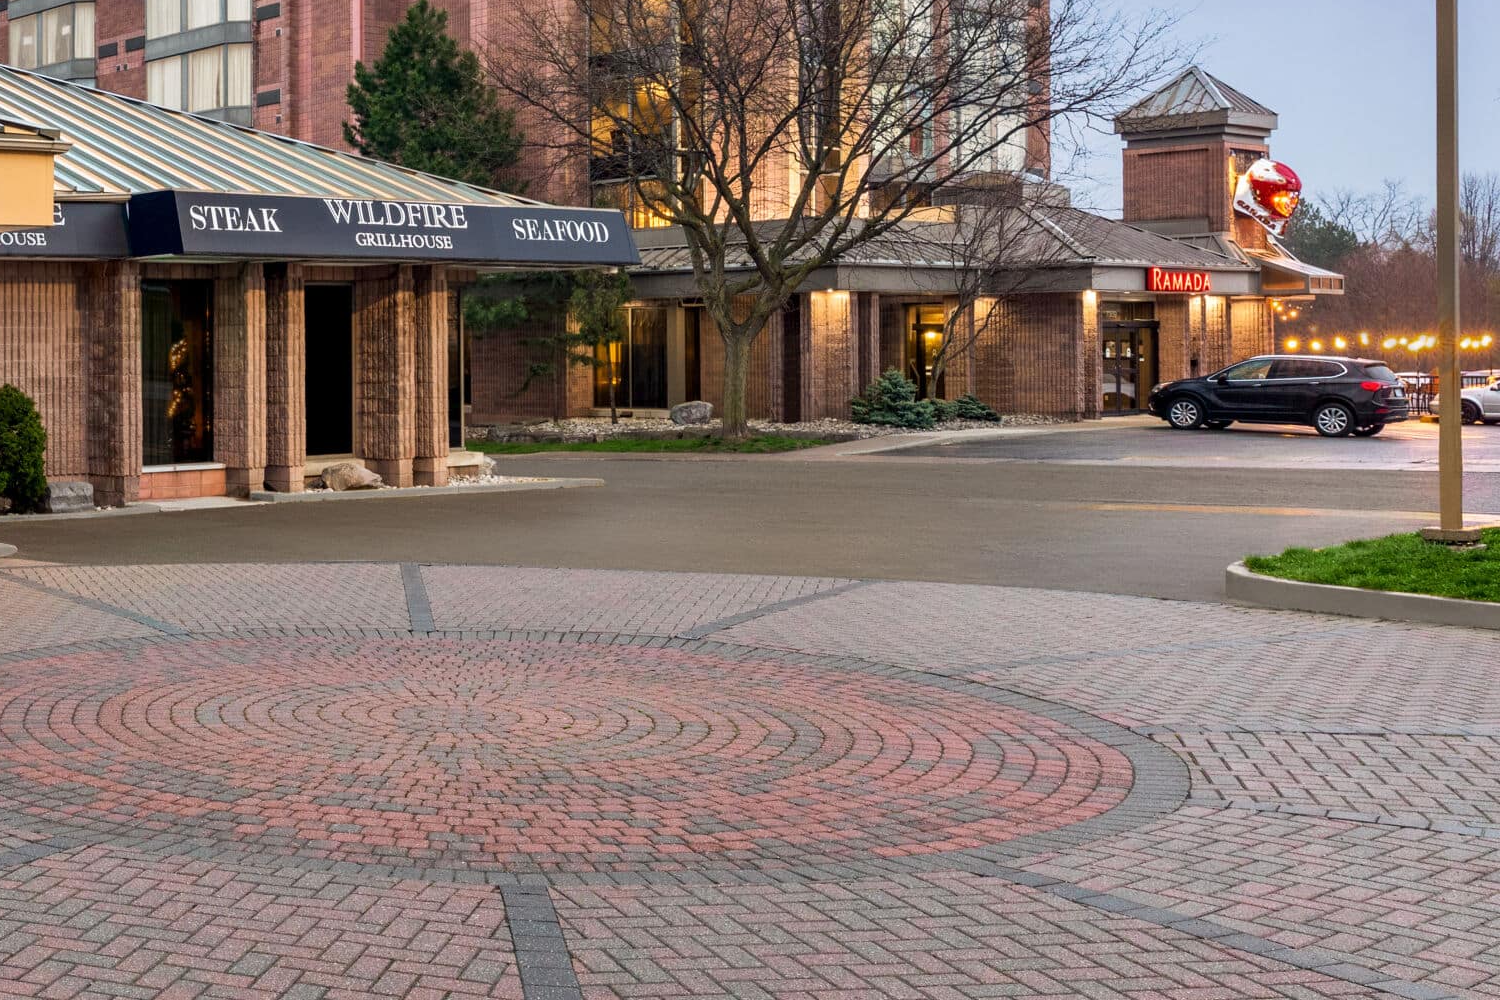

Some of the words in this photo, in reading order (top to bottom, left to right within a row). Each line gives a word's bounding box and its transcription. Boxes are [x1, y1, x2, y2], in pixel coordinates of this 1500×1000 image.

[189, 205, 283, 233] STEAK
[323, 199, 468, 229] WILDFIRE
[355, 232, 453, 249] GRILLHOUSE
[512, 218, 610, 243] SEAFOOD
[1152, 267, 1212, 291] RAMADA
